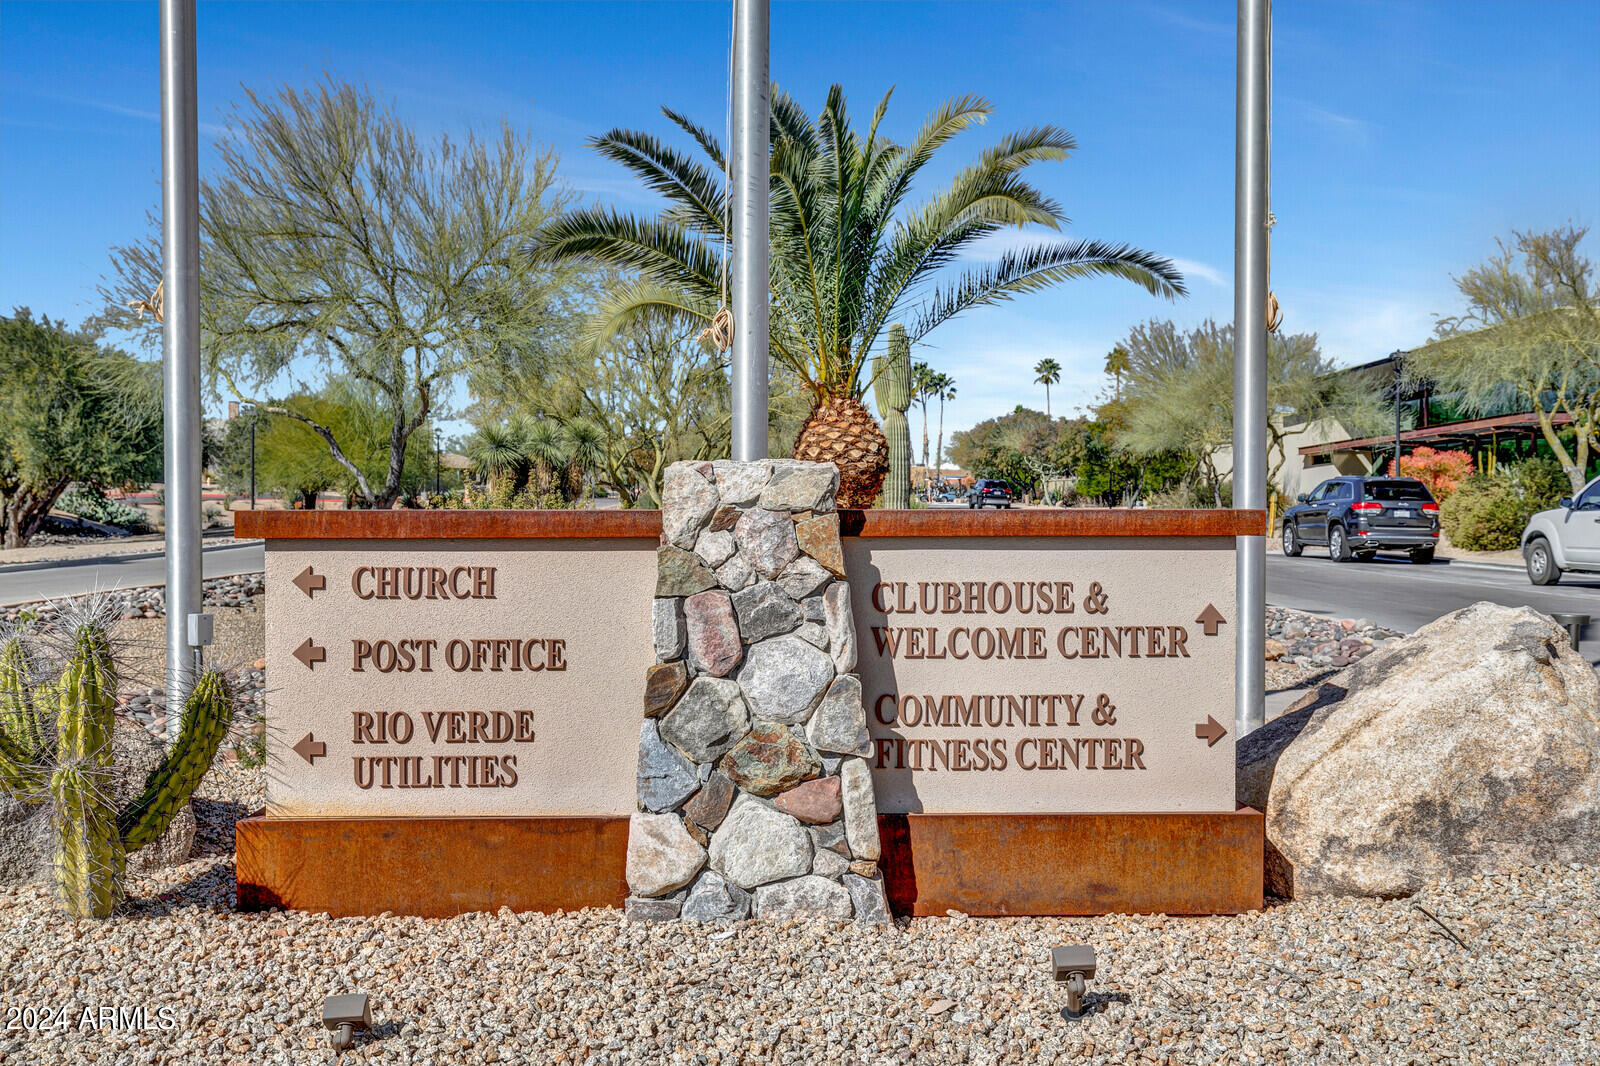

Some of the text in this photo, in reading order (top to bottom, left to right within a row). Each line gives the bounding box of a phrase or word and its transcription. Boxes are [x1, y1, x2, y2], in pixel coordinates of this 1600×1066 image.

[352, 566, 497, 600] CHURCH
[872, 581, 1109, 616] CLUBHOUSE &
[352, 638, 567, 672] POST OFFICE
[871, 625, 1191, 660] WELCOME CENTER
[352, 709, 535, 744] RIO VERDE
[874, 693, 1117, 728] COMMUNITY &
[352, 754, 518, 789] UTILITIES
[874, 737, 1147, 772] FITNESS CENTER
